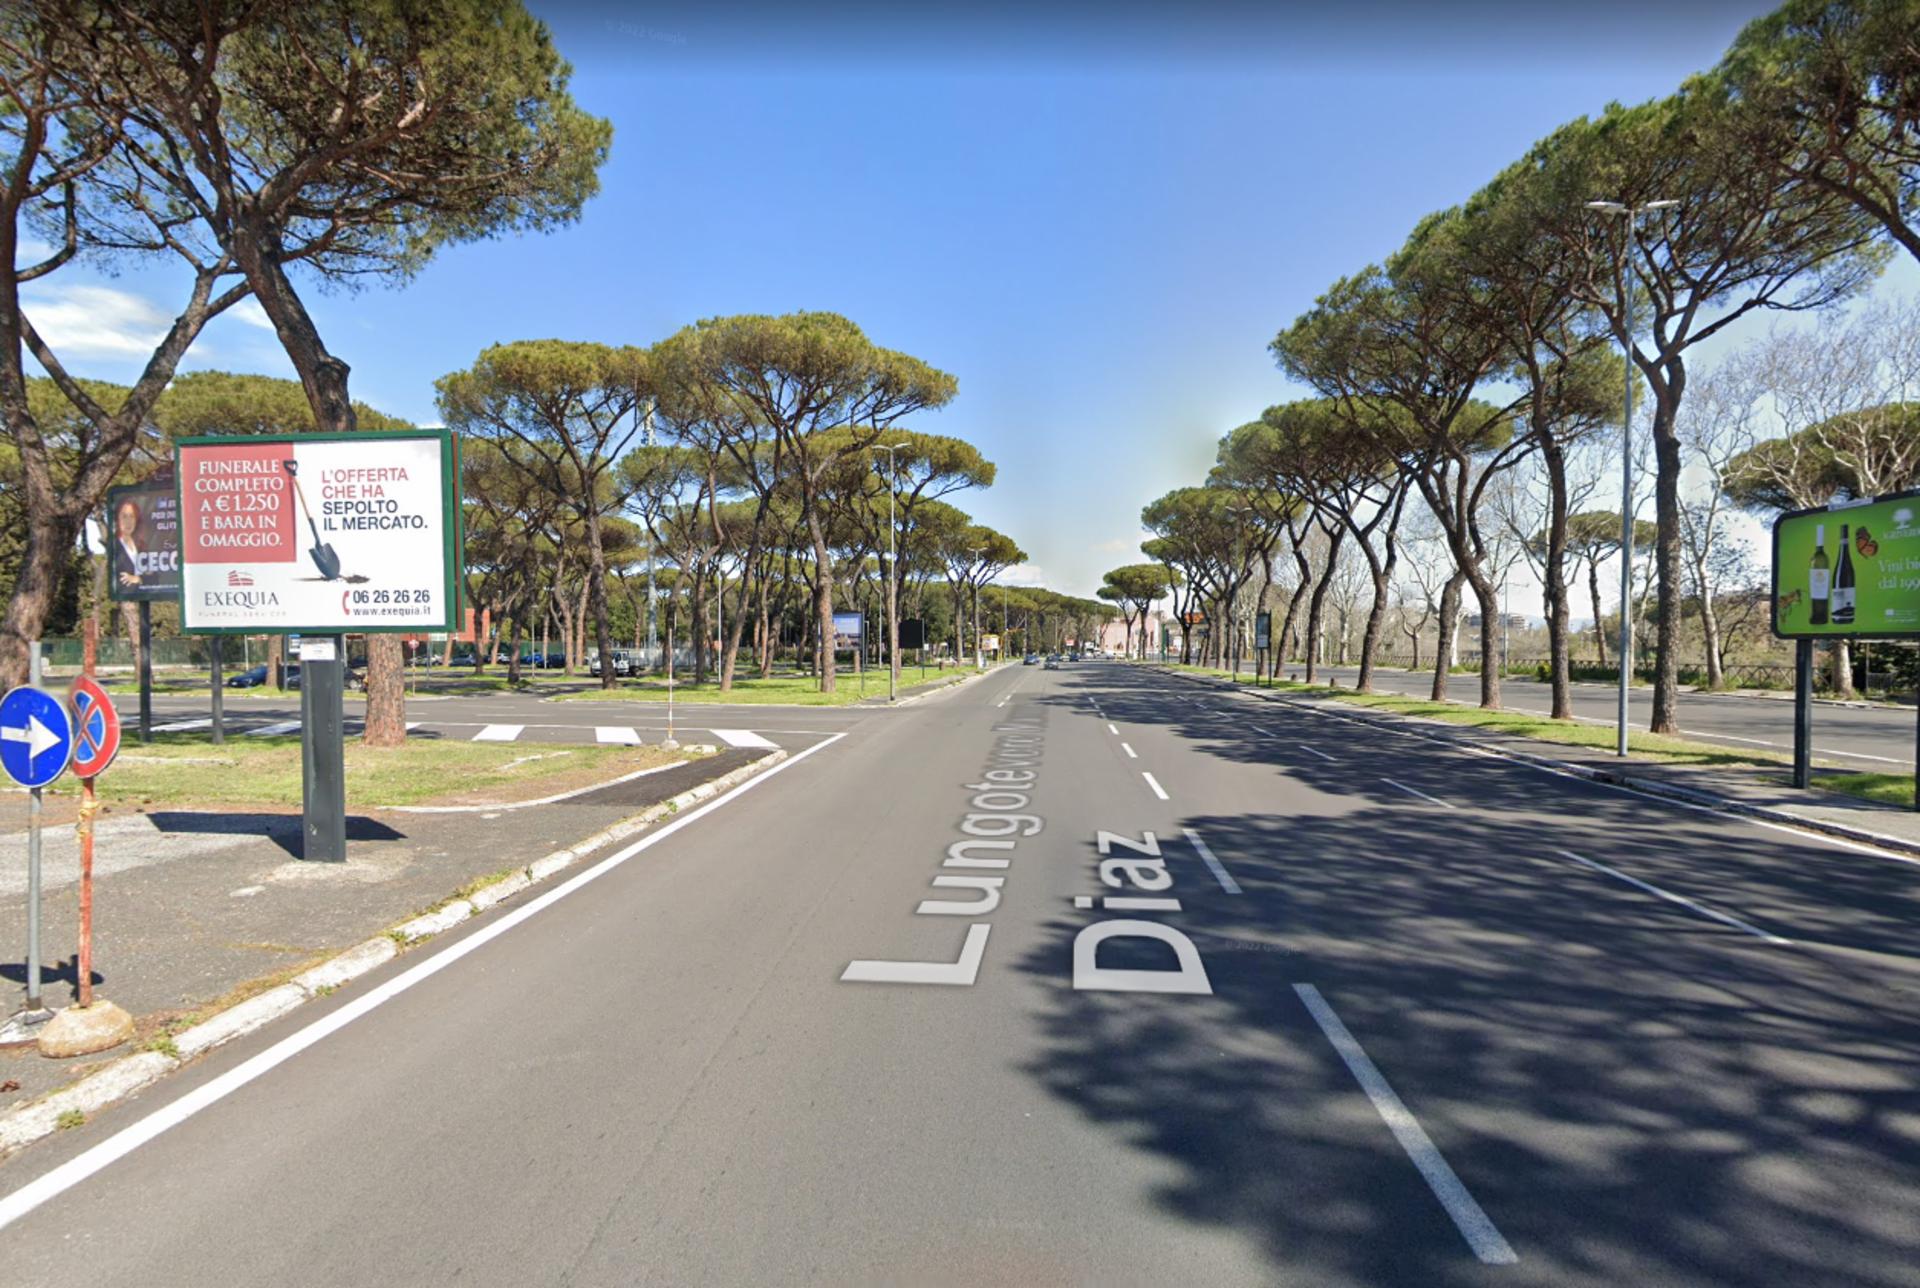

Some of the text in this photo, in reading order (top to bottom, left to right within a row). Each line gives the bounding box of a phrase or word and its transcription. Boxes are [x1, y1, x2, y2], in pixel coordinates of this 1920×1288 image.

[199, 459, 280, 475] FUNERALE
[321, 467, 409, 483] L'OFFERTA
[195, 476, 284, 493] COMPLETO
[322, 484, 385, 499] CHE HA
[200, 499, 212, 512] A
[322, 499, 398, 515] SEPOLTO
[201, 515, 277, 530] E BARA IN
[323, 515, 428, 531] IL MERCATO.
[199, 532, 283, 547] OMAGGIO.
[204, 591, 280, 609] EXEQUIA
[352, 589, 431, 604] 06 26 26 26
[353, 605, 431, 617] www.exequia.it
